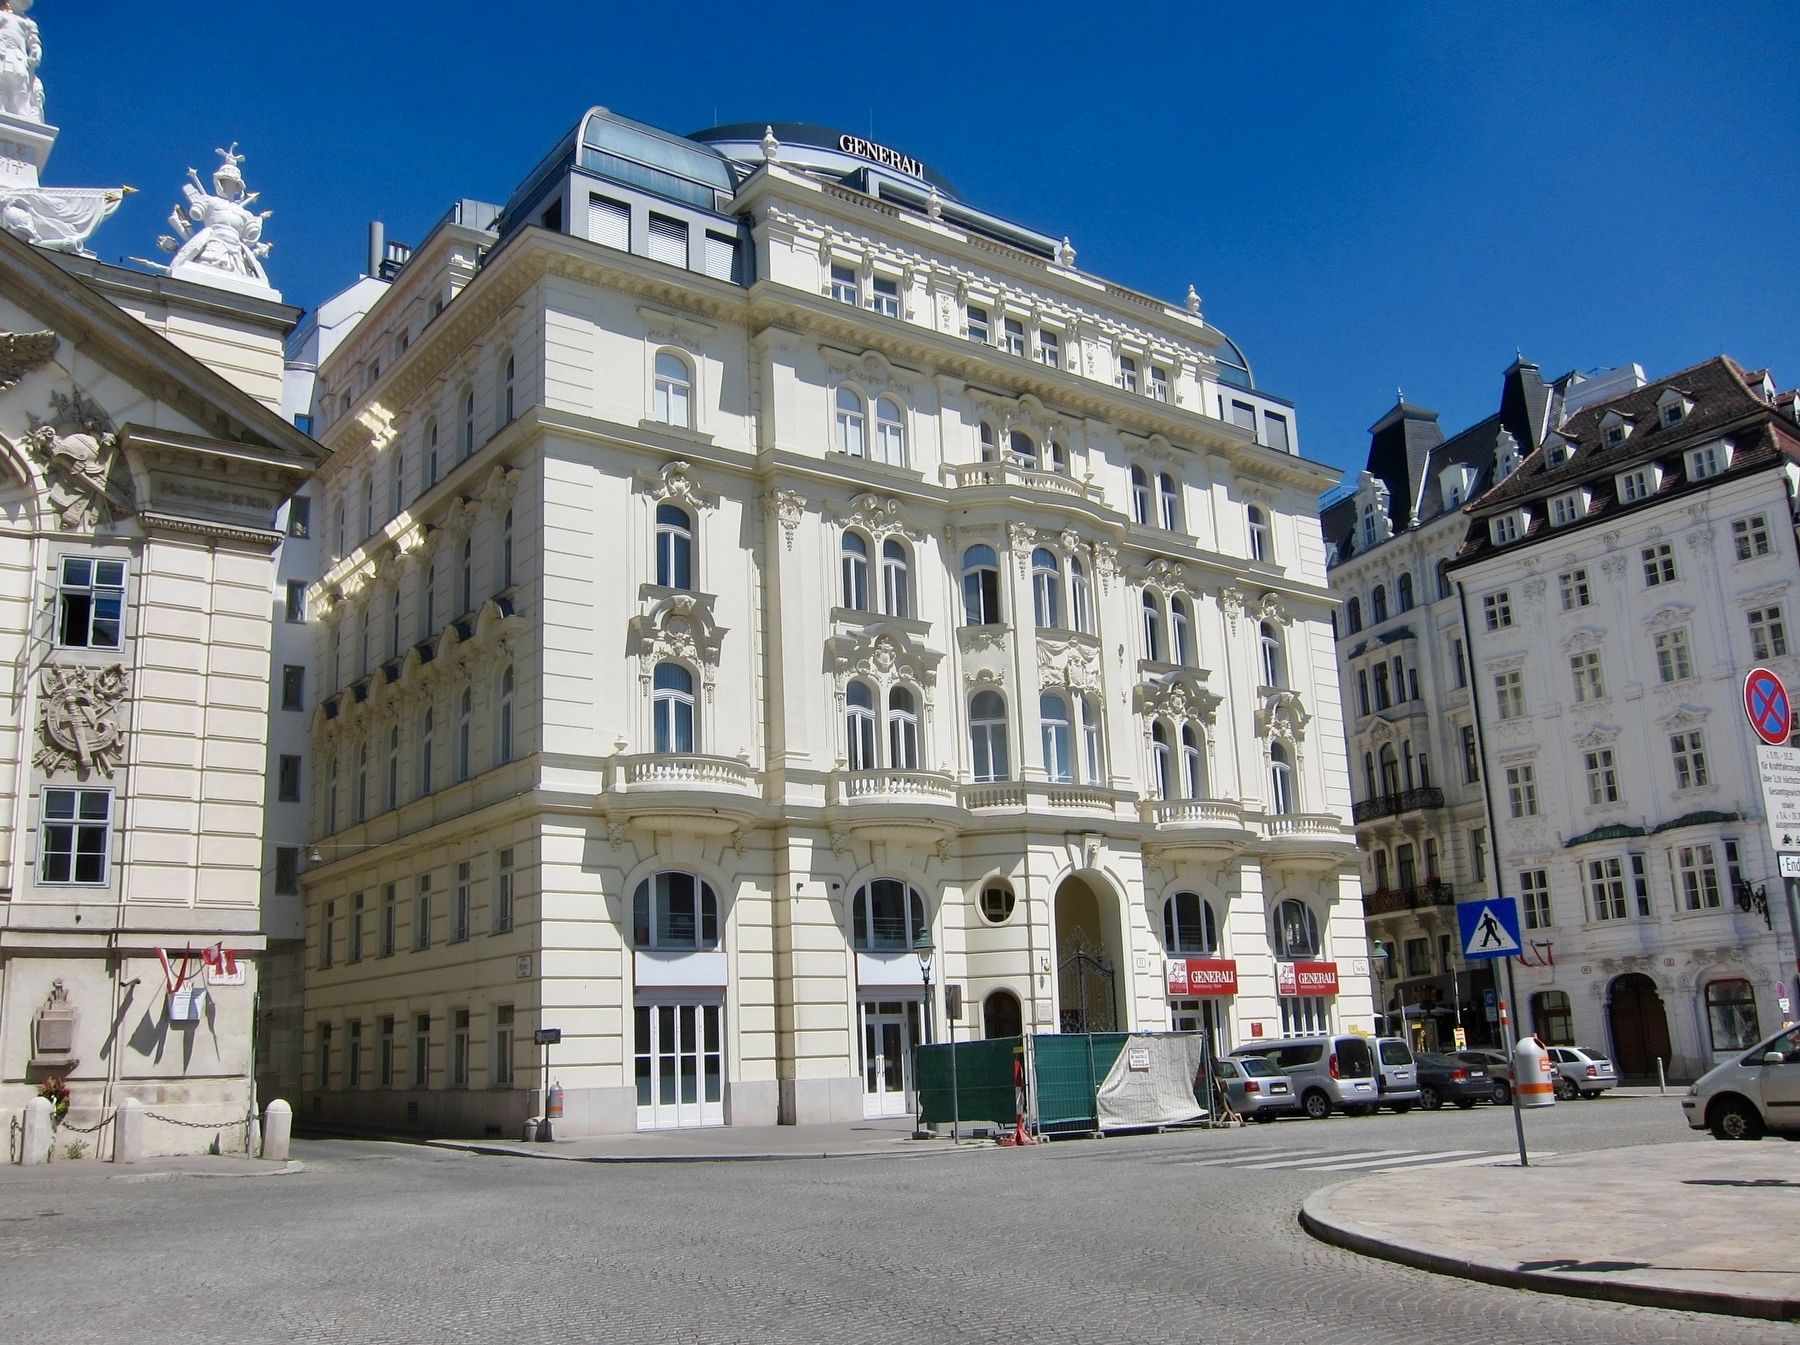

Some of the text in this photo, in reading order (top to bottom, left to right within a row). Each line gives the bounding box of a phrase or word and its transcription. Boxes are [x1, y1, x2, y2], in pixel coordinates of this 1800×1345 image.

[839, 134, 924, 181] GENERALI
[1191, 970, 1235, 984] GENERALI
[1298, 972, 1336, 984] GENERALI
